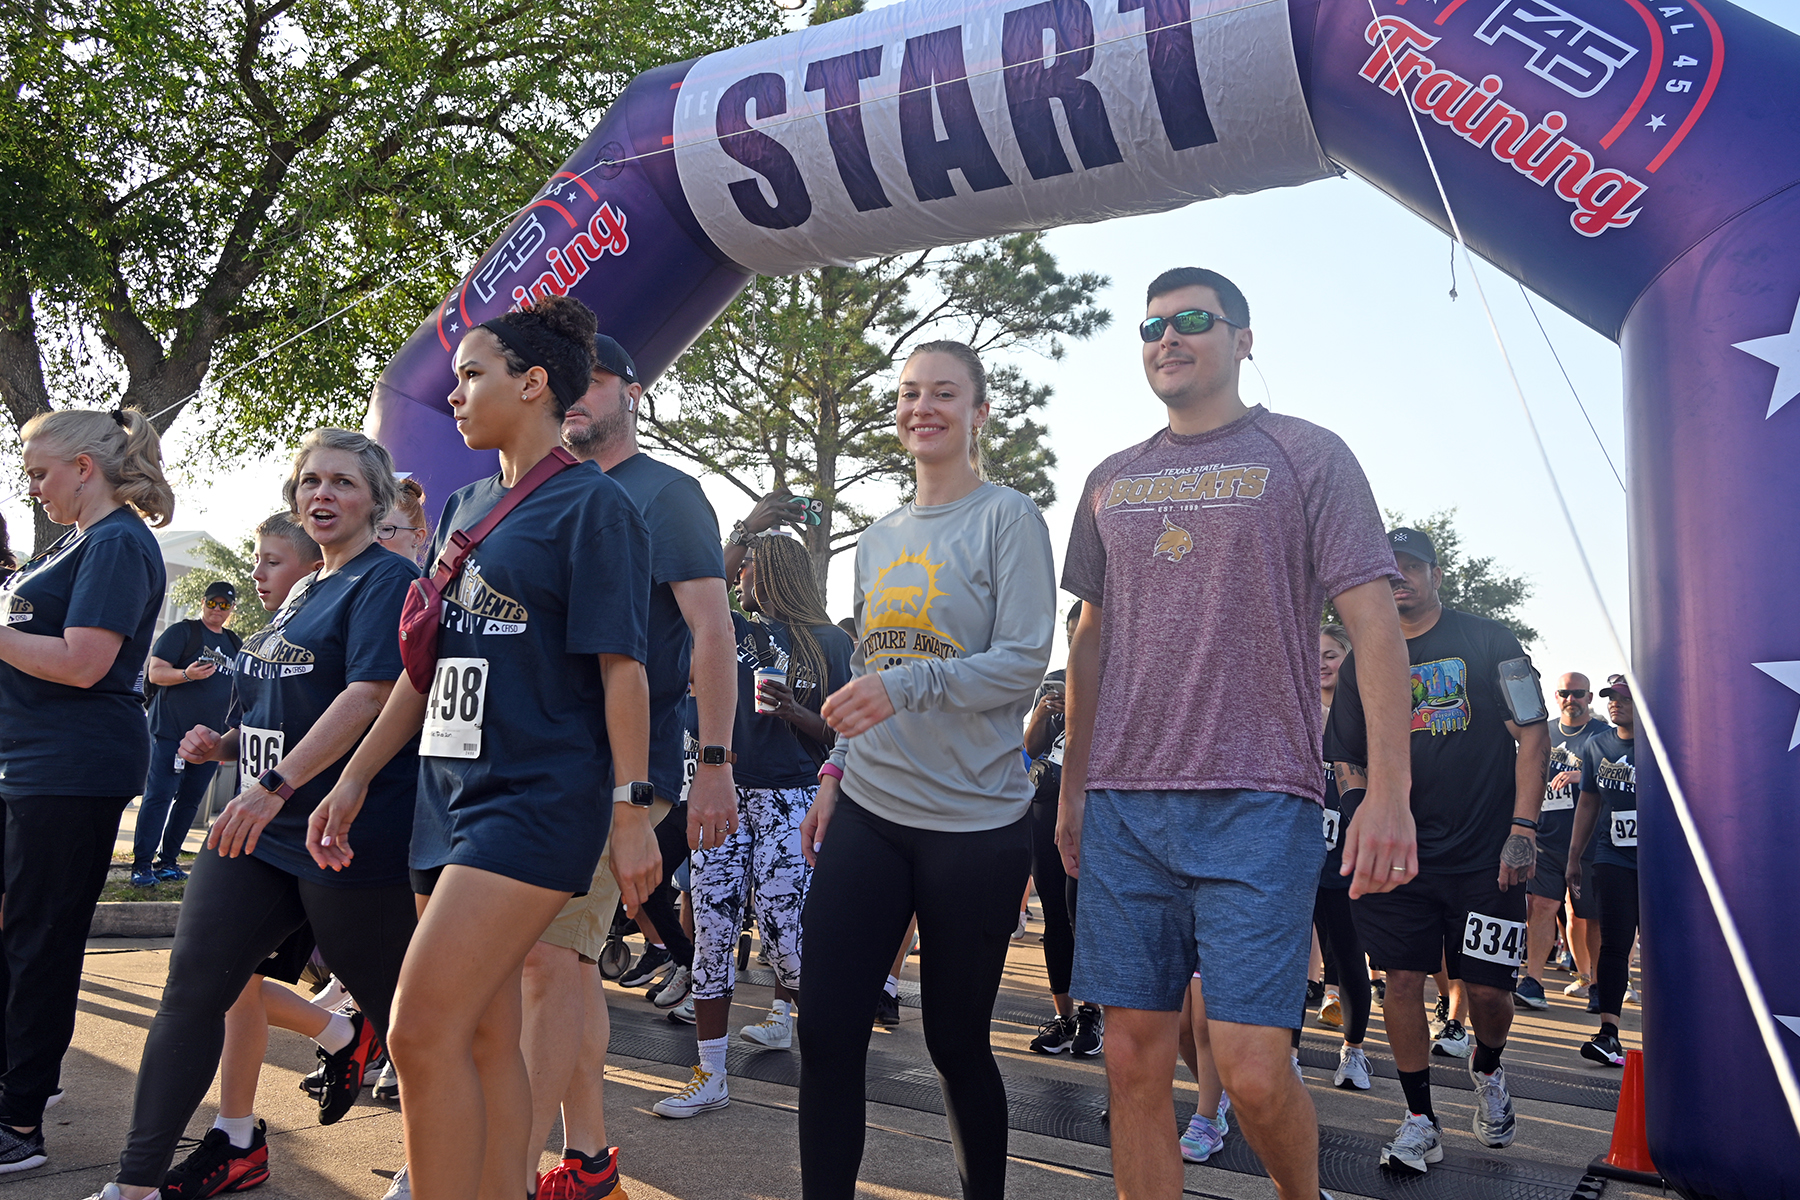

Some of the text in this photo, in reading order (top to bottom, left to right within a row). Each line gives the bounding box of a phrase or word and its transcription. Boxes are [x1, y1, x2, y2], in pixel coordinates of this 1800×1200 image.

[1473, 0, 1639, 98] F45
[715, 0, 1218, 230] START
[1358, 15, 1649, 237] Training
[471, 211, 547, 304] F45
[1106, 466, 1270, 509] BOBCATS
[1163, 463, 1220, 476] TEXAS STATE
[425, 666, 483, 722] 498
[1544, 784, 1572, 801] 814
